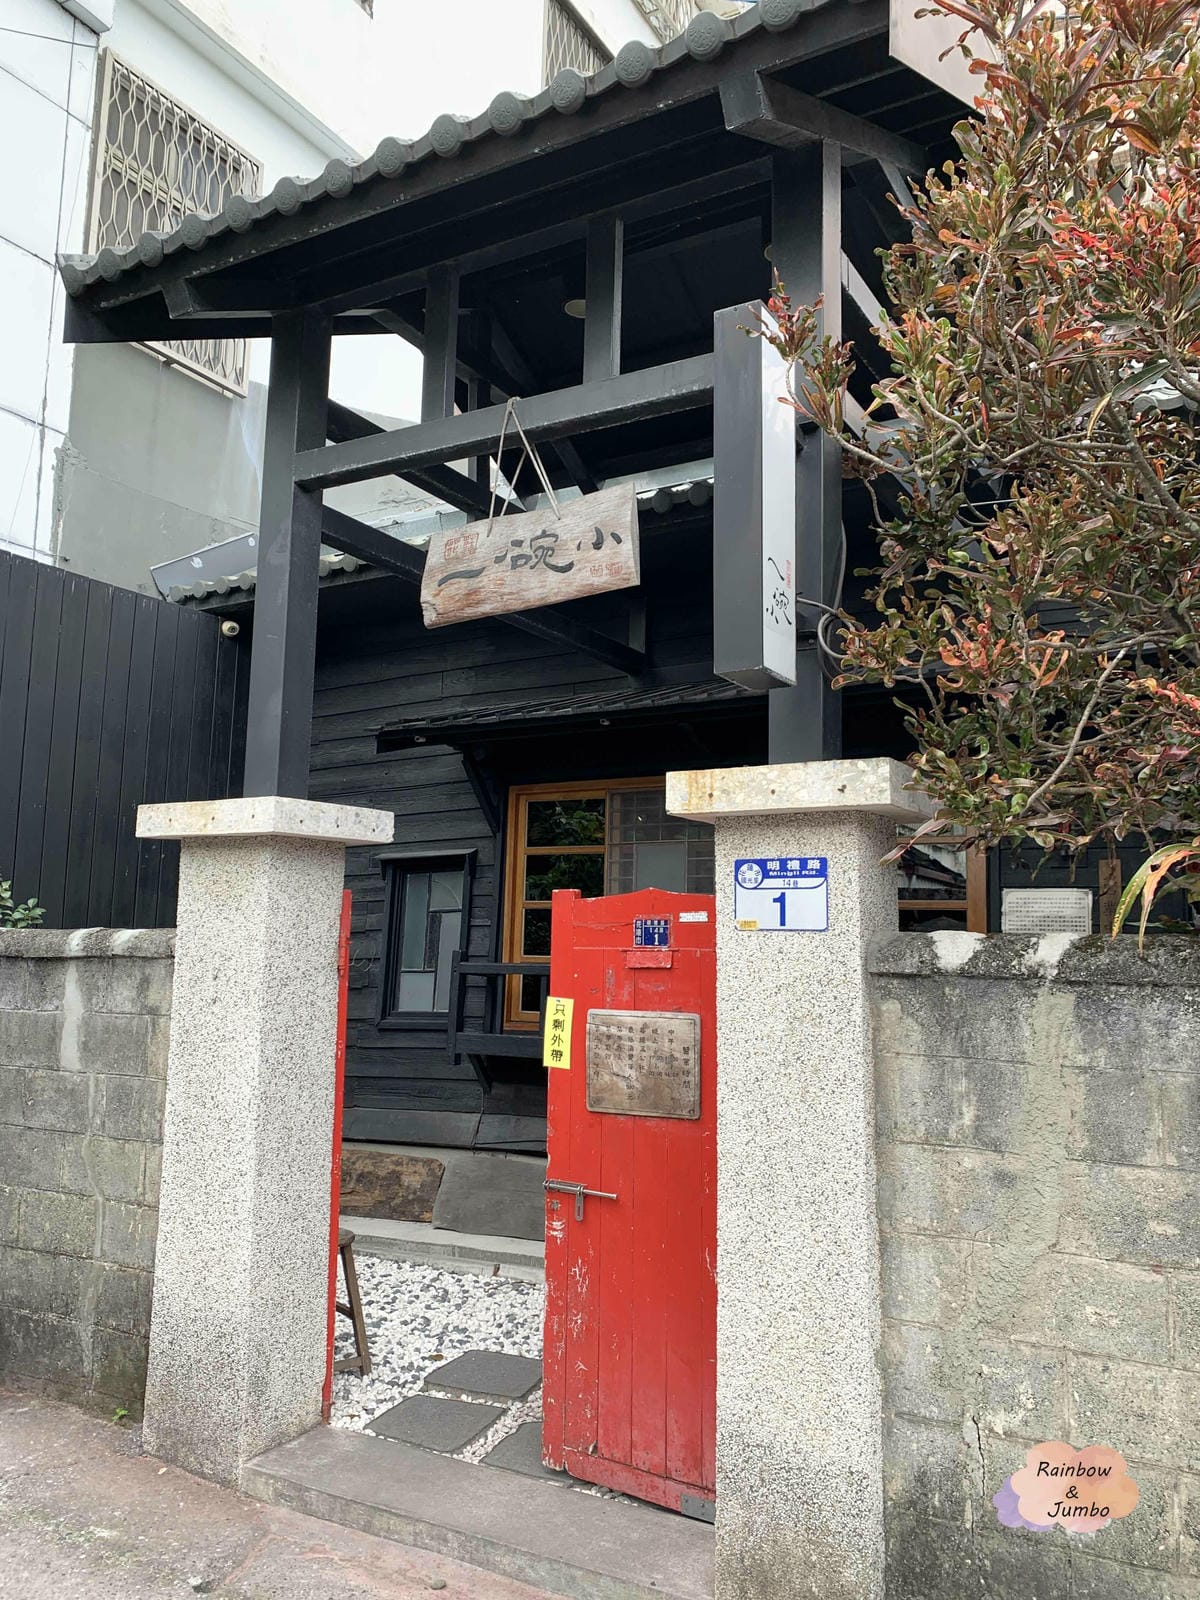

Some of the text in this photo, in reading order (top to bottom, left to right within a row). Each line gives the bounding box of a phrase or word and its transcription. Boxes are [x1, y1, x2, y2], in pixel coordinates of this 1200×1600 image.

[766, 859, 821, 871] 明禮路
[772, 891, 786, 927] 1
[654, 933, 659, 945] 1
[550, 1003, 566, 1063] 只剩外帶
